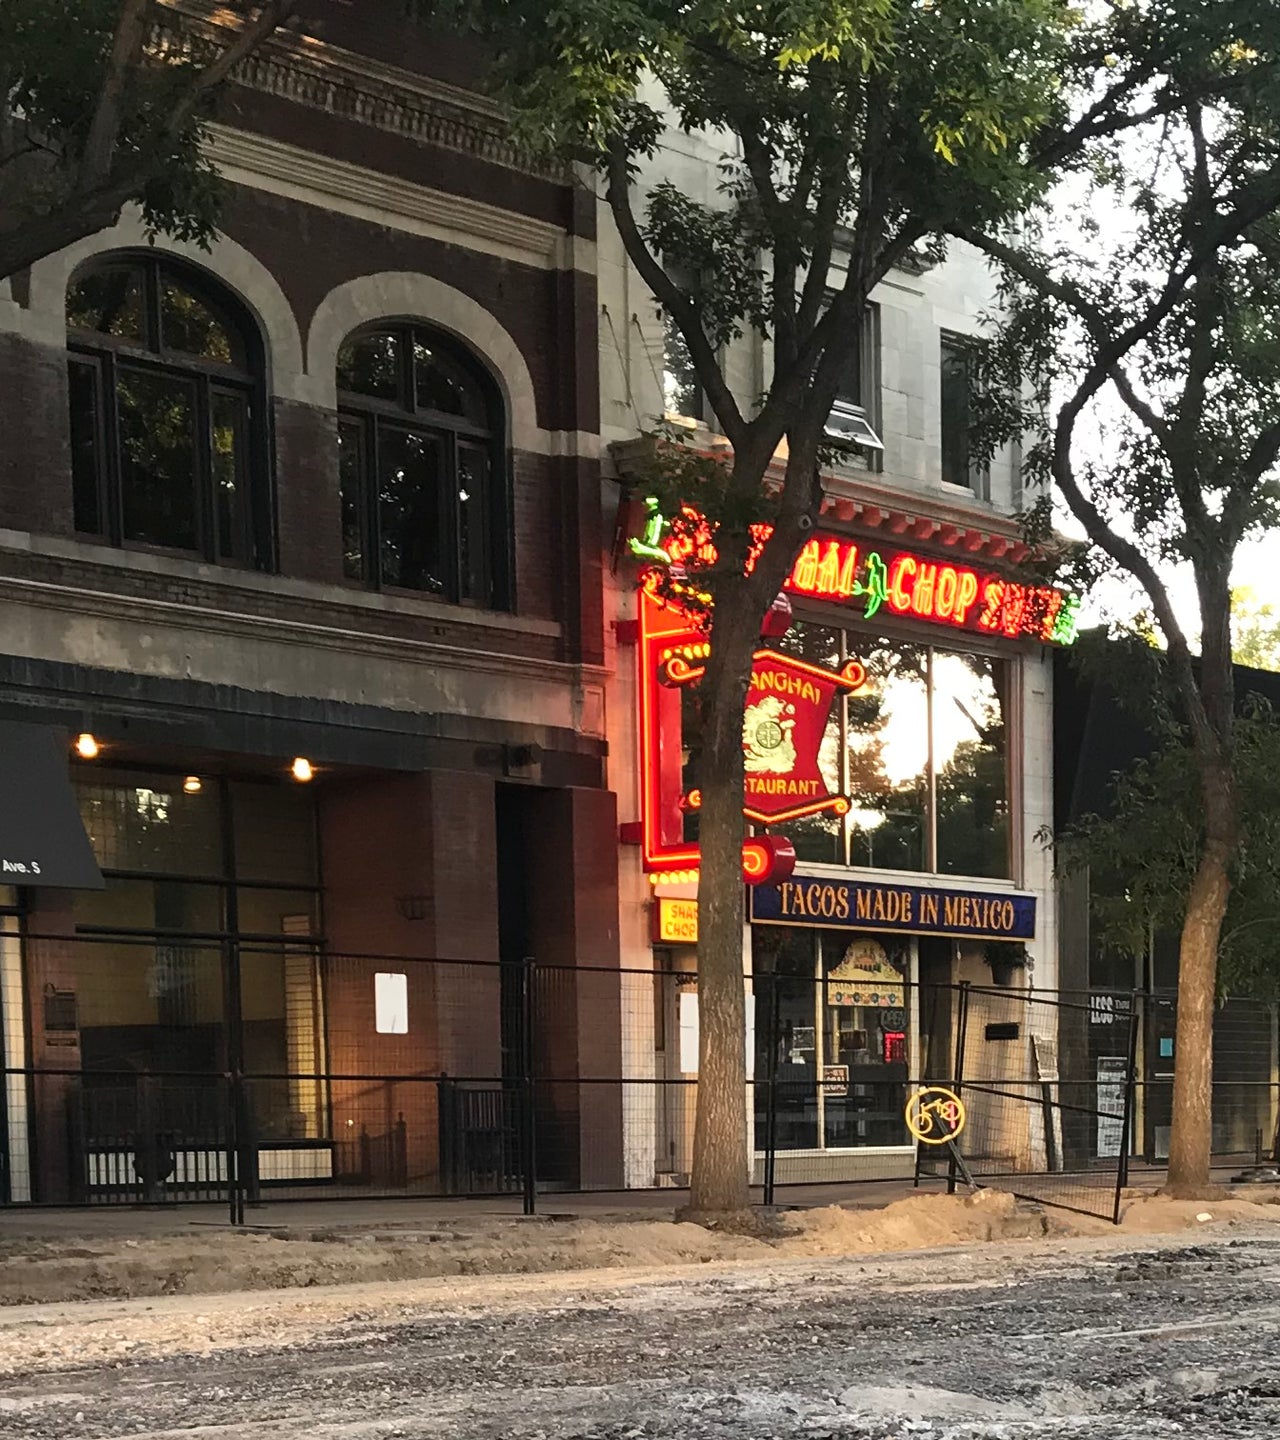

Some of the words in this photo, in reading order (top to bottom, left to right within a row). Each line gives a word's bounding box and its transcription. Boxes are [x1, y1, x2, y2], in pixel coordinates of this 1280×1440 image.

[892, 556, 978, 624] CHOP
[750, 671, 821, 705] ANGHAI
[745, 778, 820, 796] TAURANT
[2, 859, 31, 874] Ave.
[31, 861, 41, 874] S
[777, 881, 849, 919] TACOS
[856, 888, 912, 923] MADE
[919, 893, 940, 926] IN
[943, 895, 1015, 931] MEXICO
